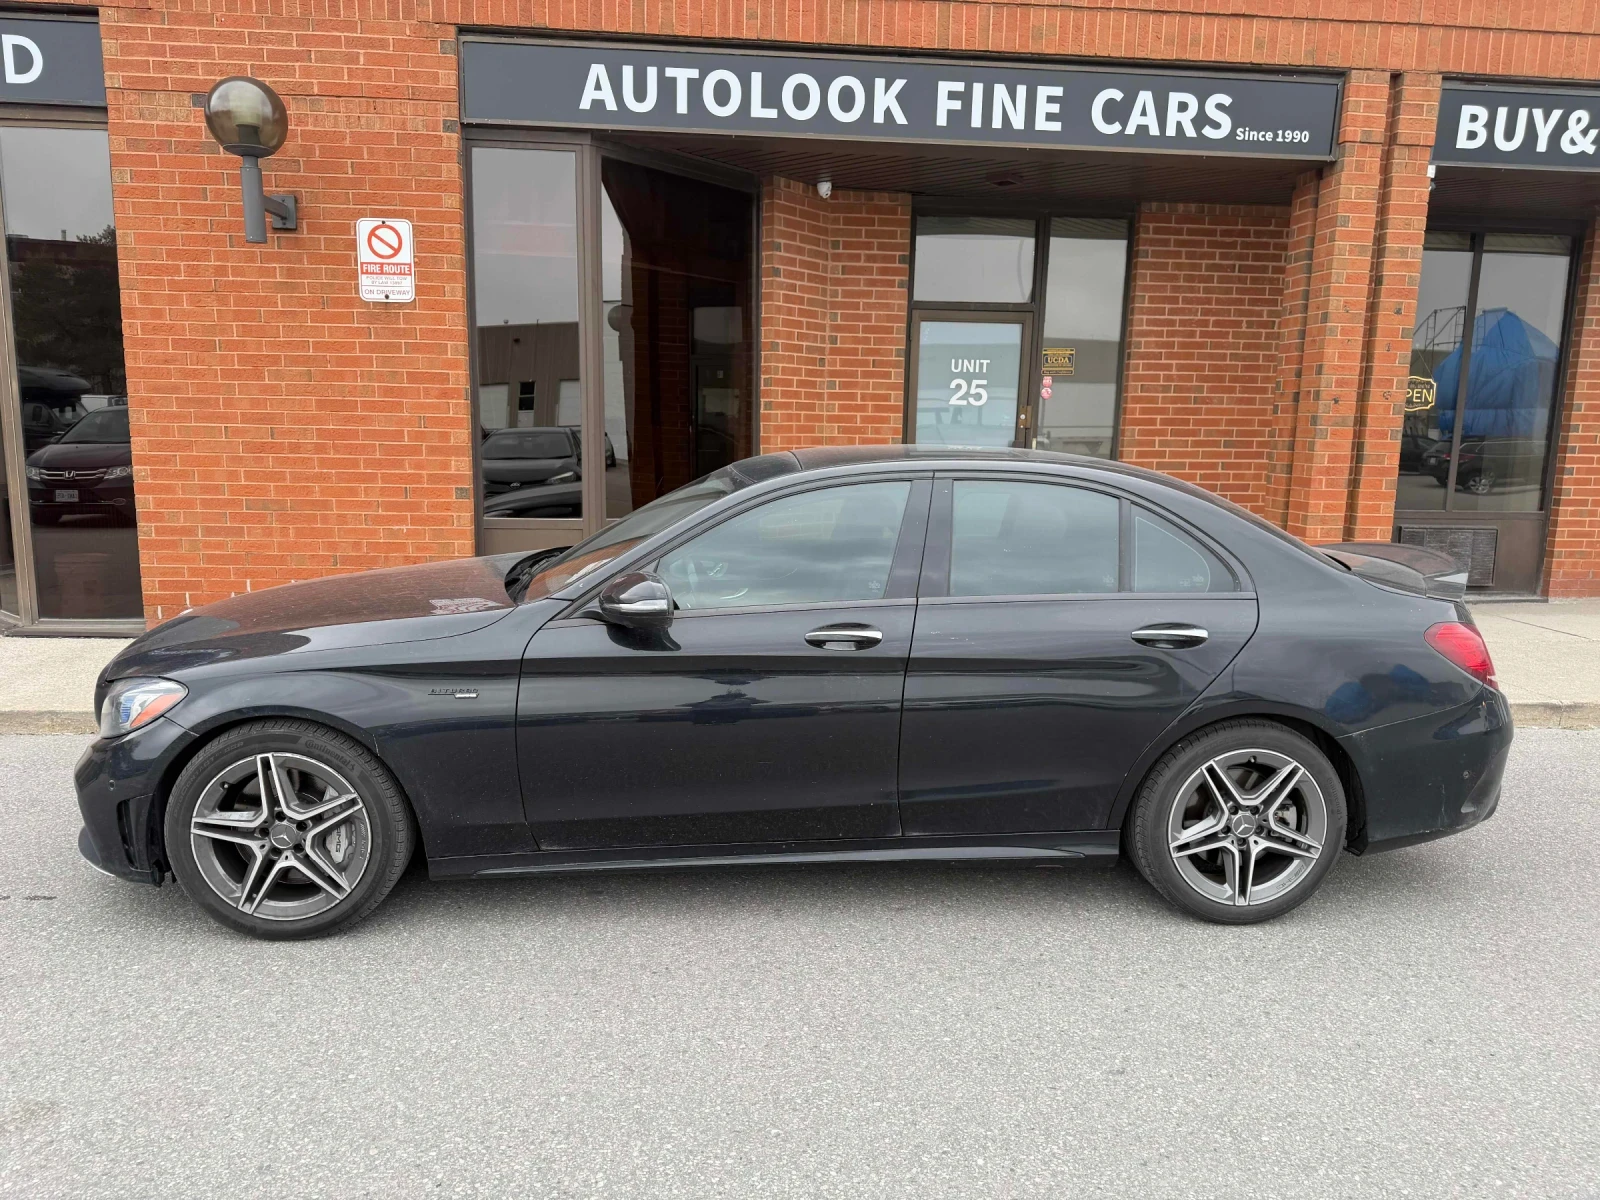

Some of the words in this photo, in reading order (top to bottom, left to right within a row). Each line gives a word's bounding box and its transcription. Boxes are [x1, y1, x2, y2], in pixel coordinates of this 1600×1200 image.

[2, 34, 43, 83] D
[579, 63, 908, 124] AUTOLOOK
[936, 80, 1063, 131] FINE
[1091, 88, 1233, 140] CARS
[1236, 127, 1273, 141] Since
[1276, 130, 1309, 143] 1990
[1456, 105, 1600, 155] BUY&
[363, 264, 381, 273] FIRE
[383, 265, 410, 274] ROUTE
[951, 358, 990, 373] UNIT
[1047, 356, 1069, 364] UCDA
[948, 378, 988, 406] 25
[1406, 389, 1433, 402] PEN
[304, 739, 351, 768] Continental
